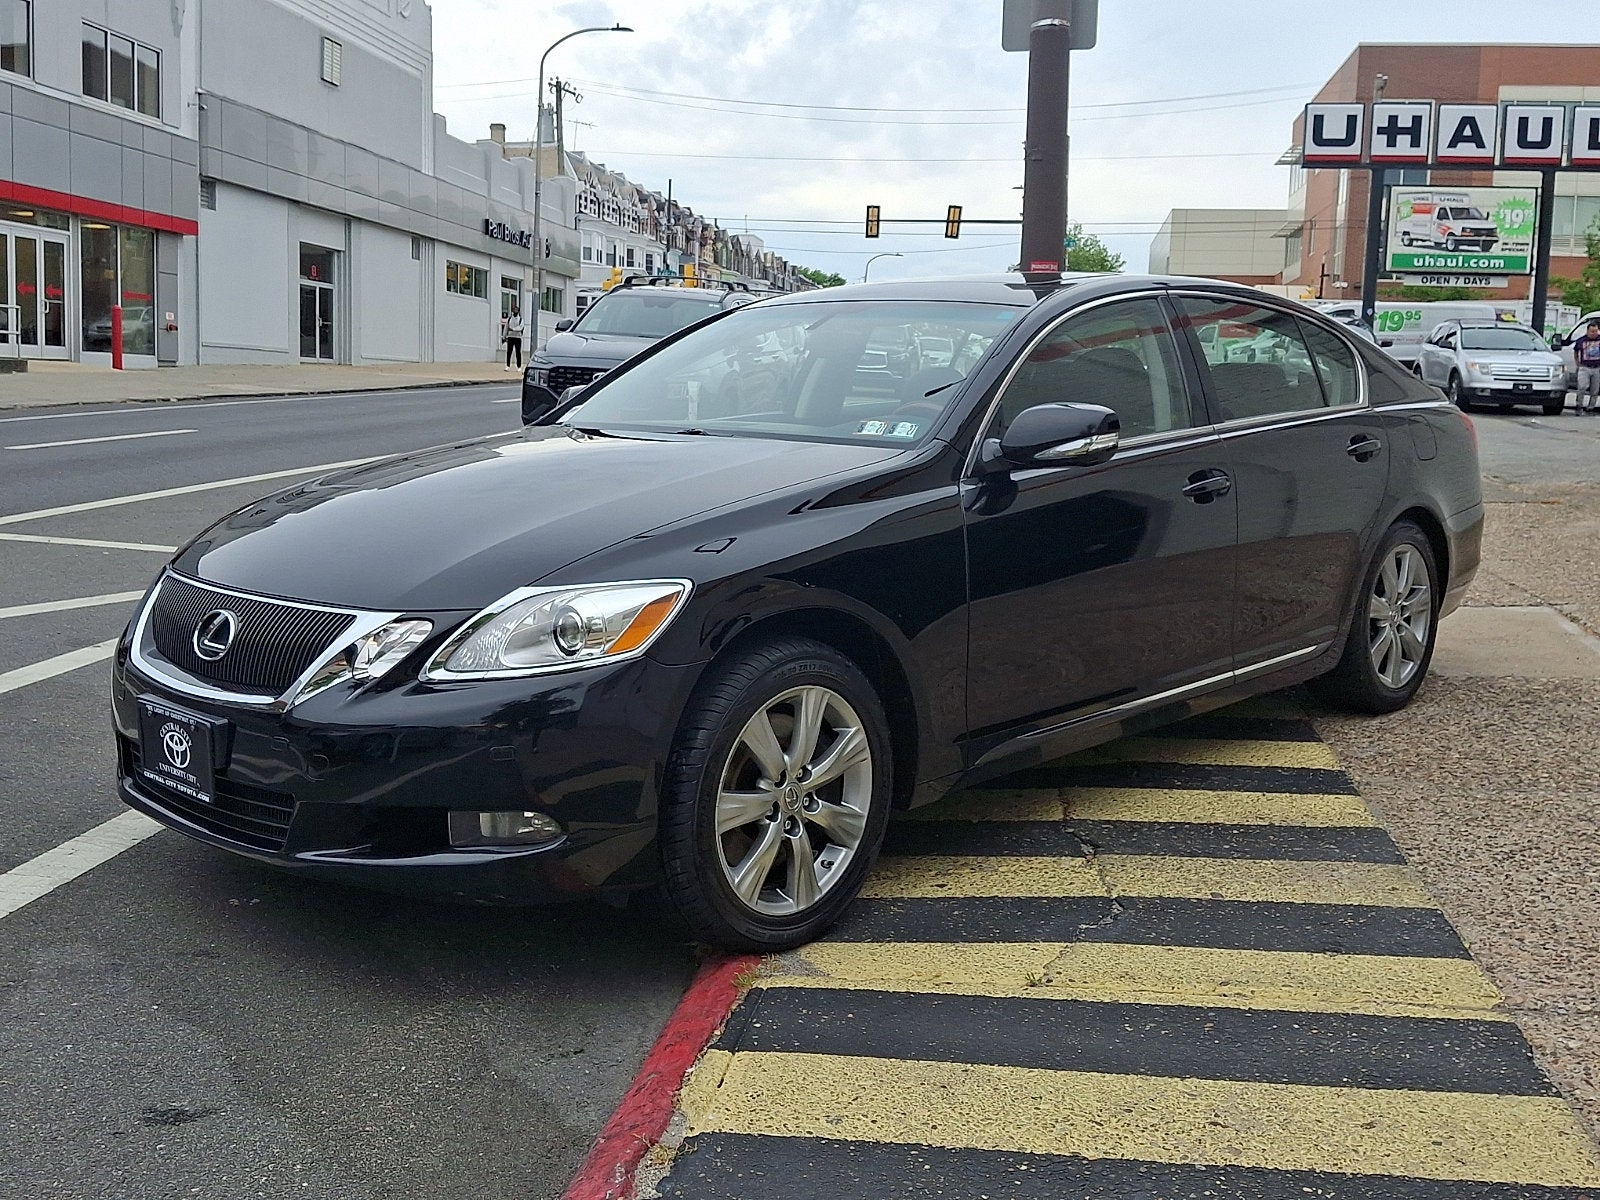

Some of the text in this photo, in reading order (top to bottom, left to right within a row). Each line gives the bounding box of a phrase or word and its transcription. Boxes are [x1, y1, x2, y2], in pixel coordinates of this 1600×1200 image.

[484, 218, 504, 240] Paul
[504, 223, 522, 246] Bros.
[1413, 255, 1505, 269] uhaul.com
[1421, 276, 1491, 286] OPEN 7 DAYS
[144, 771, 165, 784] CENTRAL
[165, 779, 177, 789] CITY
[159, 762, 187, 780] UNIVERSITY
